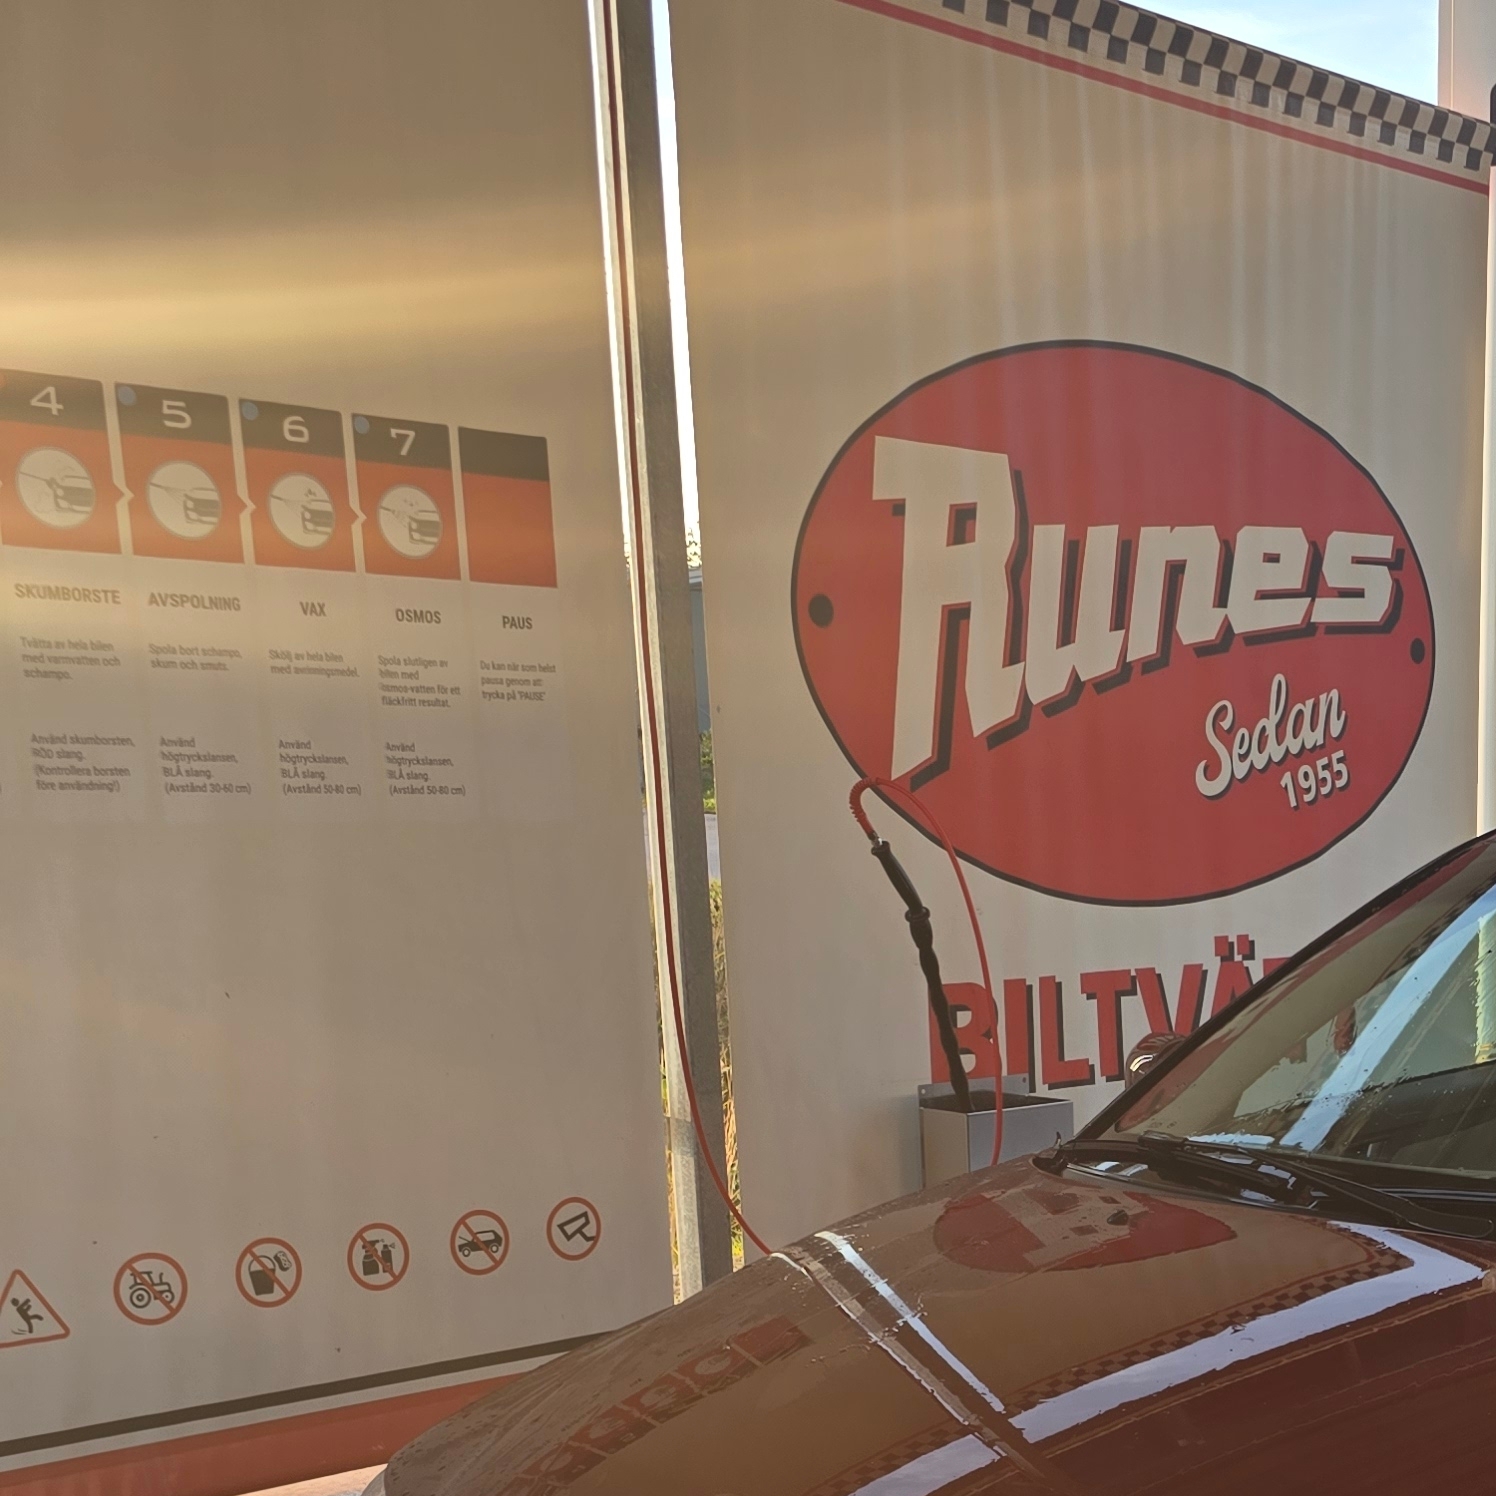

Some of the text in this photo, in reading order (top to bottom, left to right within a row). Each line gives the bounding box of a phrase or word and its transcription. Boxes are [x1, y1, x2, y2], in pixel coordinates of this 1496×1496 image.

[29, 385, 64, 416] 4
[161, 400, 193, 430] 5
[282, 415, 310, 444] 6
[389, 428, 417, 456] 7
[14, 583, 121, 605] SKUMBORSTE
[148, 592, 241, 611] AVSPOLNING
[299, 601, 327, 617] VAX
[871, 434, 1402, 790] Runes
[395, 608, 442, 624] OSMOS
[502, 615, 533, 630] PAUS
[20, 636, 114, 652] Tvätta av hela bilen
[149, 643, 177, 656] Spola
[179, 645, 199, 656] bort
[22, 653, 44, 664] med
[102, 656, 120, 667] och
[294, 653, 304, 661] av
[378, 655, 401, 667] Spola
[439, 659, 448, 668] av
[151, 658, 178, 669] skum
[180, 659, 198, 670] och
[271, 664, 291, 674] med
[480, 660, 490, 670] Du
[492, 661, 505, 671] kan
[521, 664, 537, 672] som
[401, 670, 419, 680] med
[505, 678, 531, 687] genom
[437, 684, 448, 694] för
[450, 686, 461, 695] ett
[31, 733, 67, 745] Använd
[160, 736, 196, 747] Använd
[1193, 673, 1347, 798] Sedan
[278, 739, 311, 750] Använd
[386, 742, 415, 752] Använd
[93, 765, 131, 776] borsten
[162, 764, 183, 777] BLÅ
[281, 766, 300, 778] BLÅ
[1279, 749, 1350, 810] 1955
[165, 781, 207, 795] (Avstånd
[235, 782, 252, 795] cm)
[282, 783, 362, 796] (Avstånd 50-80 cm)
[389, 785, 466, 797] (Avstånd 50-80 cm)
[927, 934, 1293, 1094] BILTVÄ
